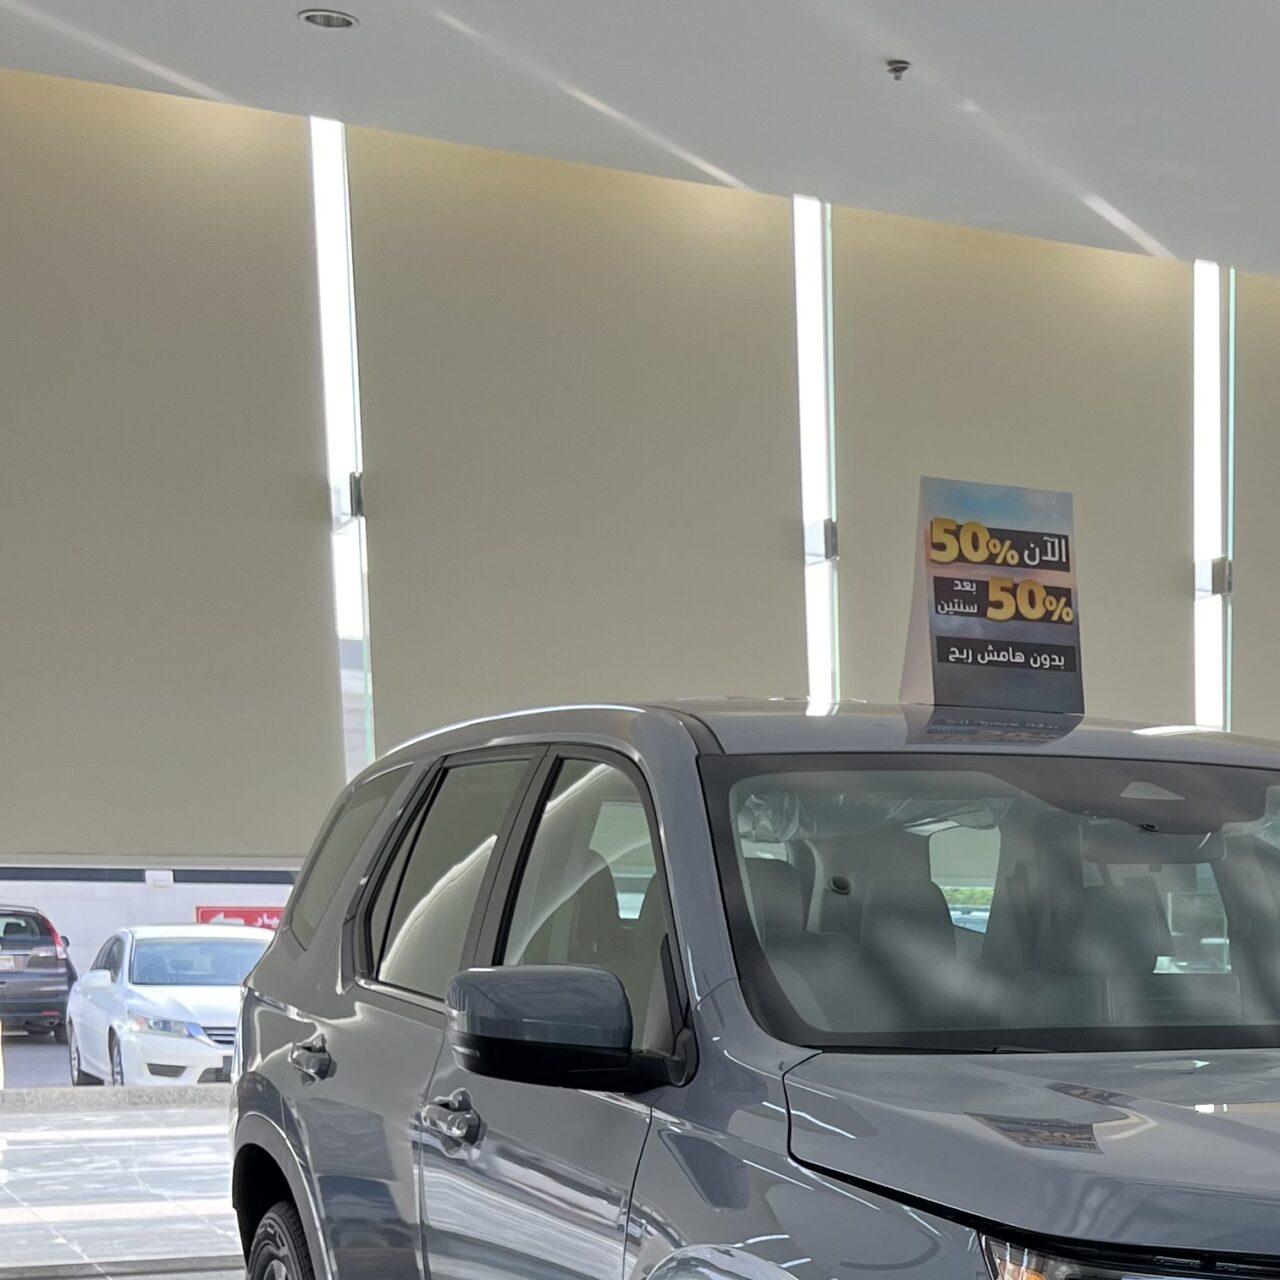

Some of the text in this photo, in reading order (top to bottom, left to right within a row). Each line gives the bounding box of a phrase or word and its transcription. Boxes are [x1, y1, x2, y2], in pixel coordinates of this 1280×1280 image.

[929, 517, 1067, 566] الآن 50%
[953, 579, 977, 595] بعد
[986, 576, 1074, 622] 50%
[937, 599, 978, 614] سنتين
[948, 645, 1065, 669] بدون هامش ربح
